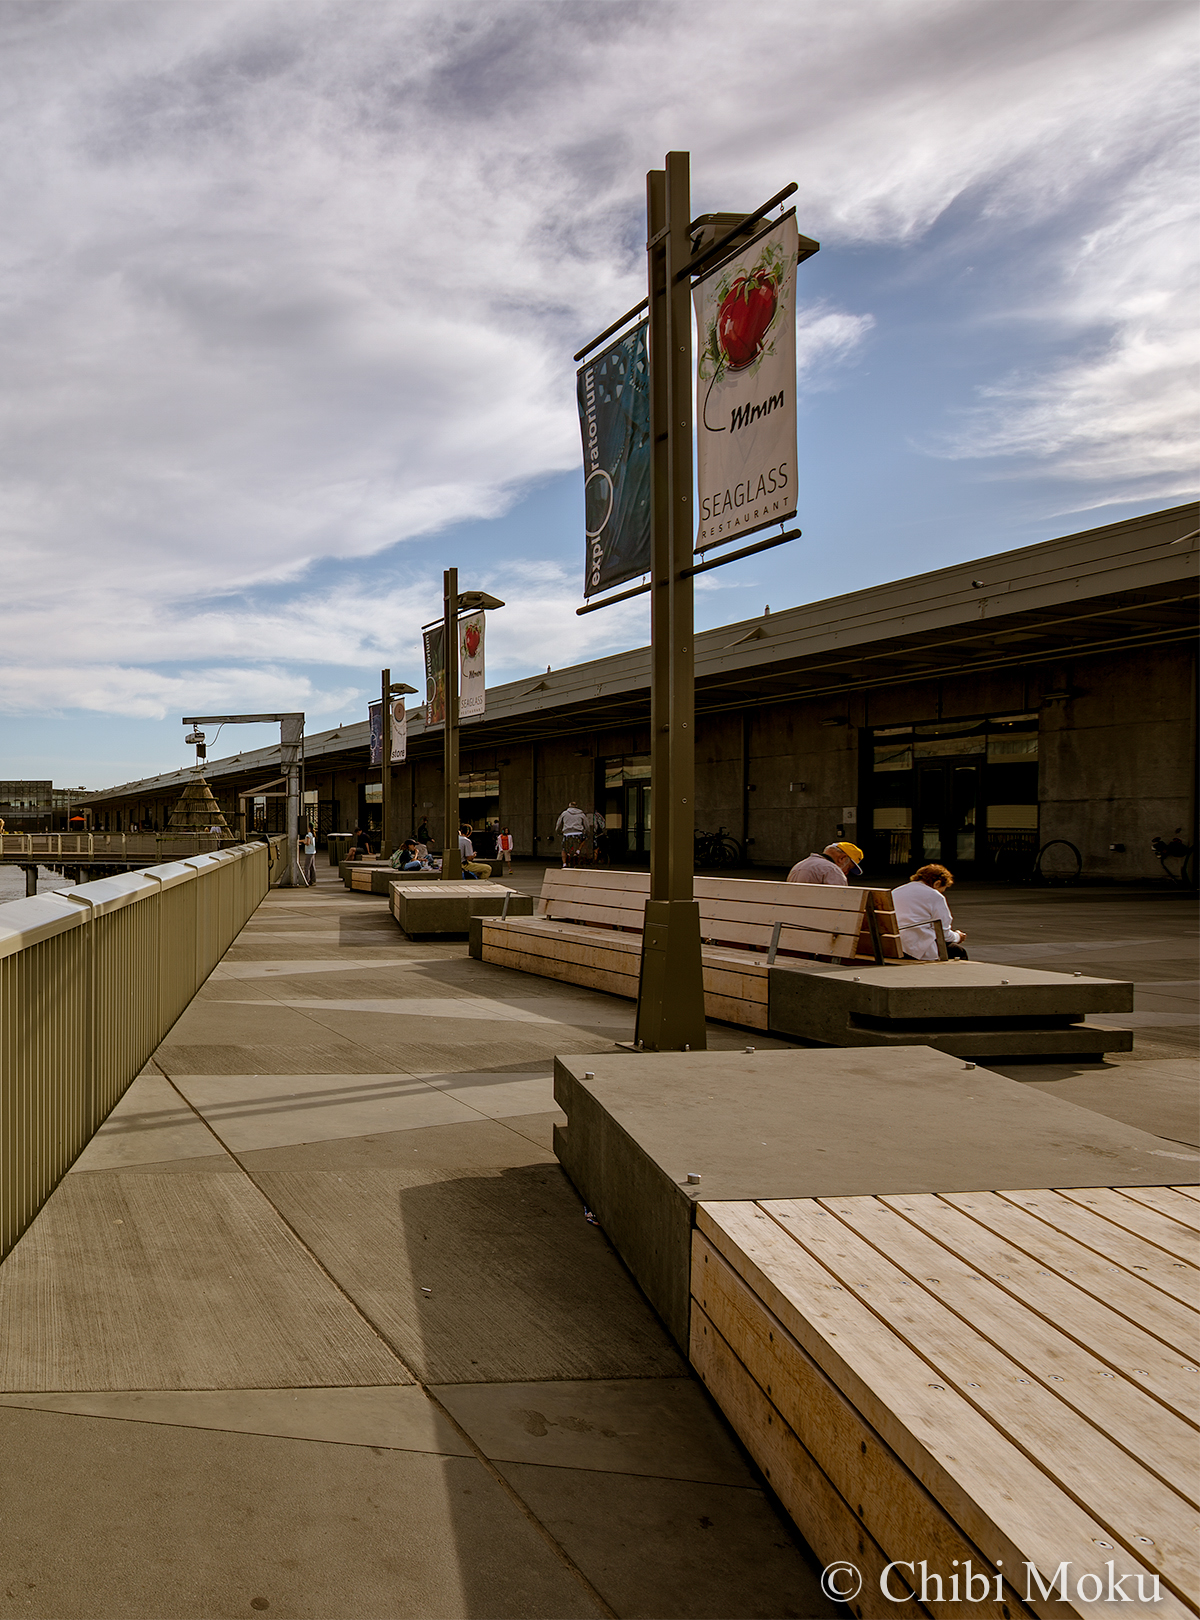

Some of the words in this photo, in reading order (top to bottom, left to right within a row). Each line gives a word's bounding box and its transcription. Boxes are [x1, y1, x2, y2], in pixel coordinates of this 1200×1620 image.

[729, 389, 785, 434] Mmm
[701, 462, 789, 521] SEAGLASS
[701, 496, 790, 539] RESTAURANT
[460, 694, 483, 709] SEAGLASS
